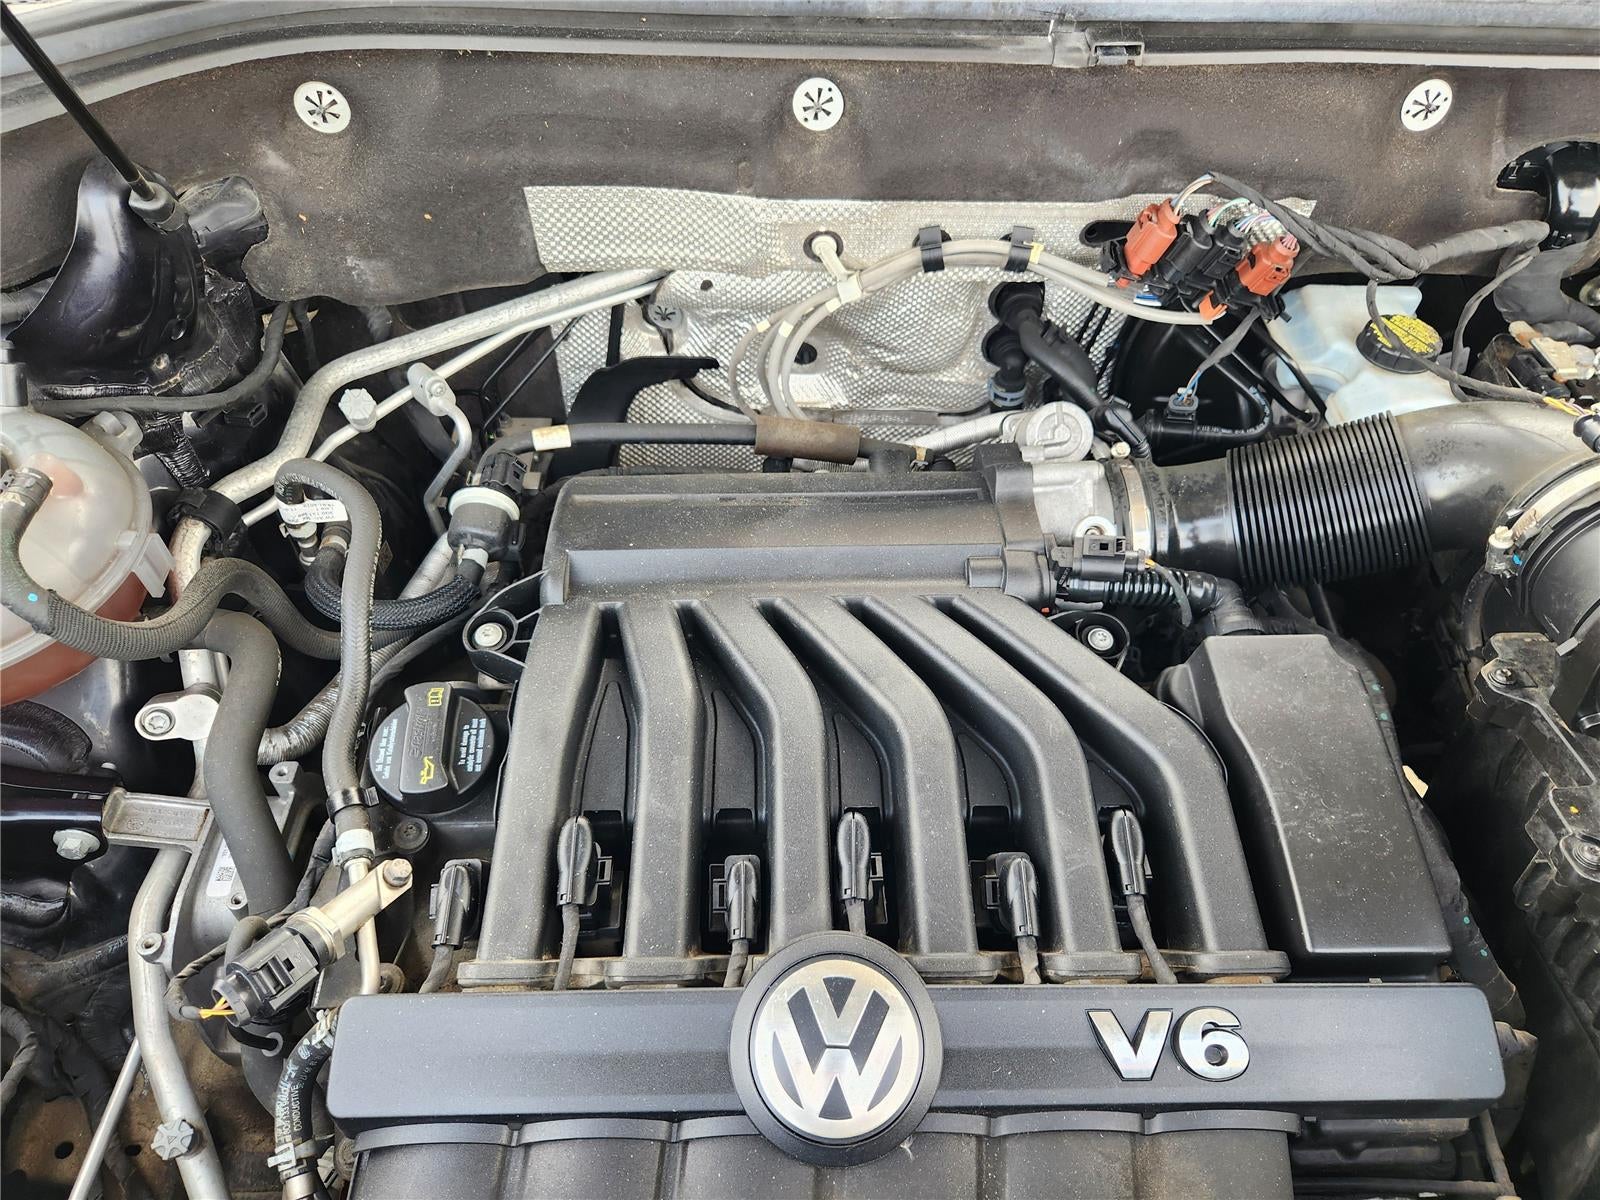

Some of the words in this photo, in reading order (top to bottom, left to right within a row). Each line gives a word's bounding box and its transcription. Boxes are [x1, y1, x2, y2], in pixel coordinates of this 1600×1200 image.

[752, 962, 921, 1137] VW
[1085, 1005, 1251, 1082] V6
[290, 1082, 303, 1132] CONDUCTIVE
